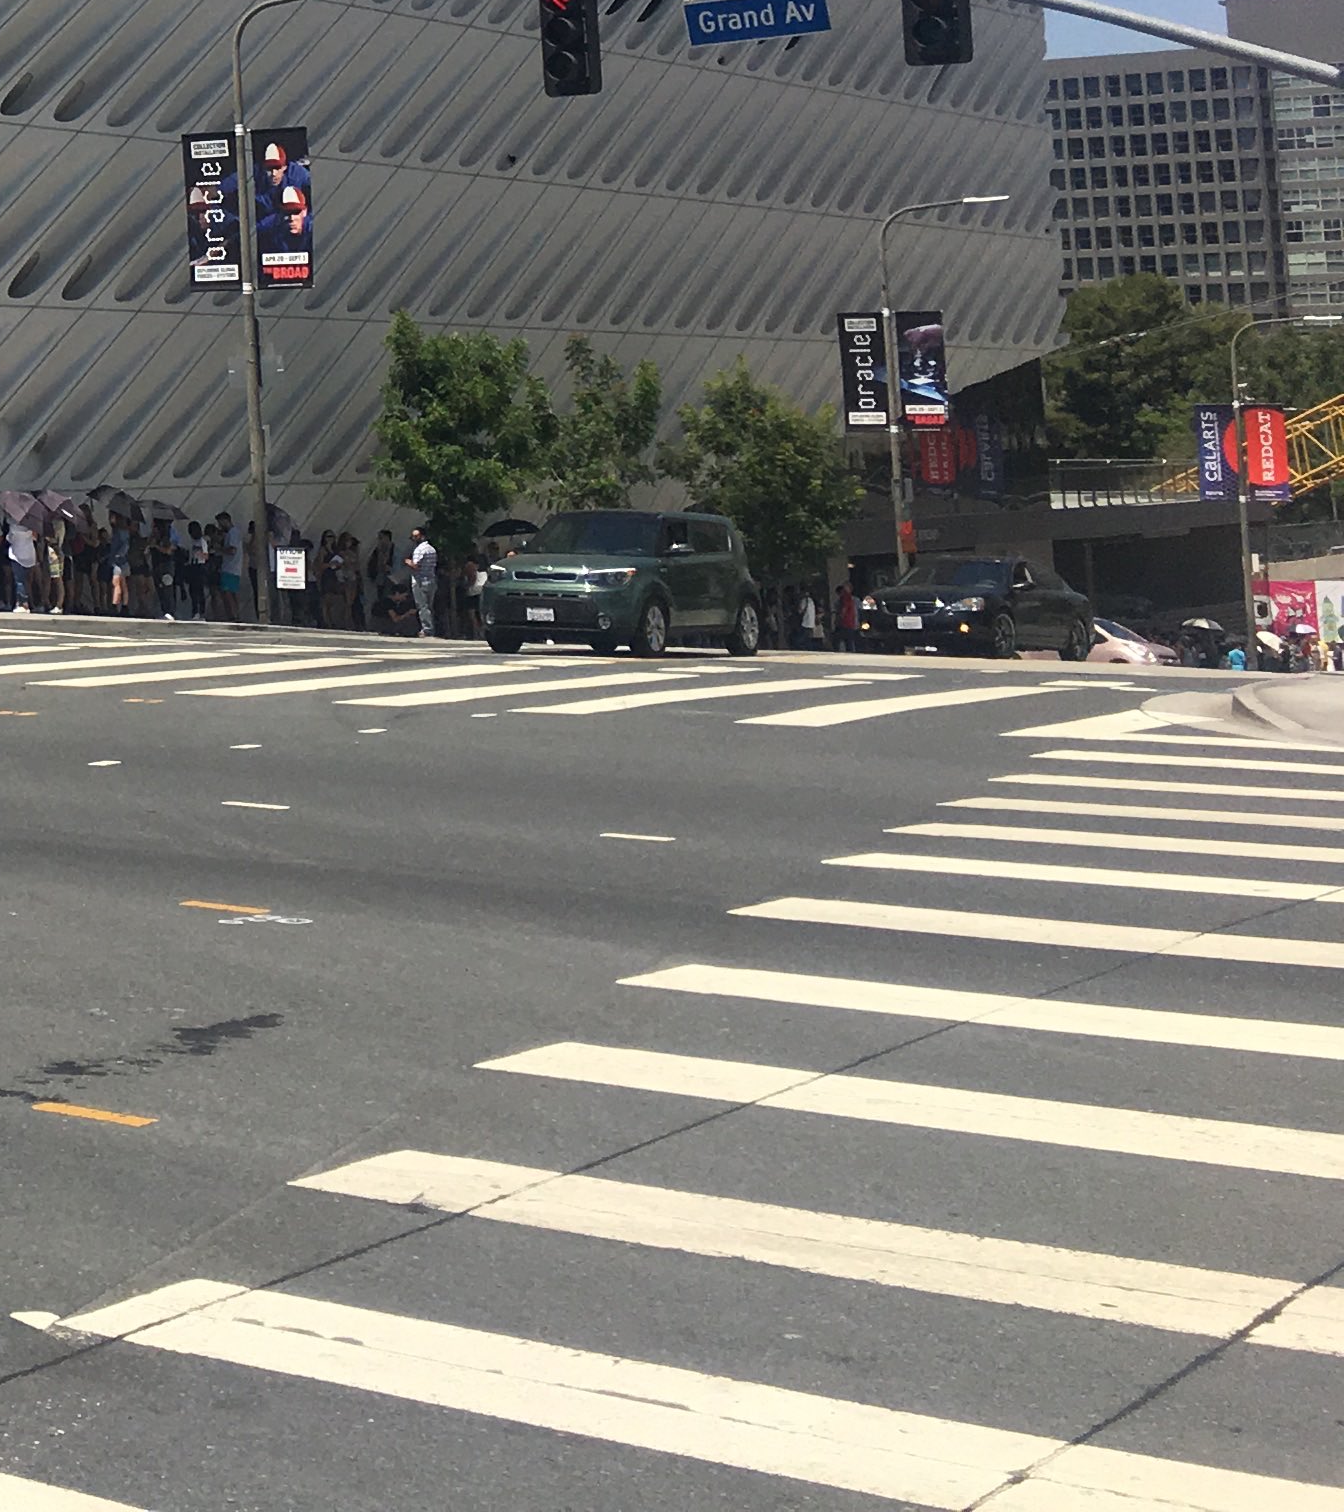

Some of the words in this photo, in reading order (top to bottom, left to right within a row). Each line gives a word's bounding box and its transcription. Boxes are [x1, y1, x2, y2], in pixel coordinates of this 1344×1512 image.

[698, 3, 775, 33] Grand
[785, 1, 815, 24] Av
[196, 162, 226, 260] oracle
[273, 266, 309, 279] BROAD
[849, 334, 876, 409] oracle
[1258, 411, 1275, 482] REDCAT
